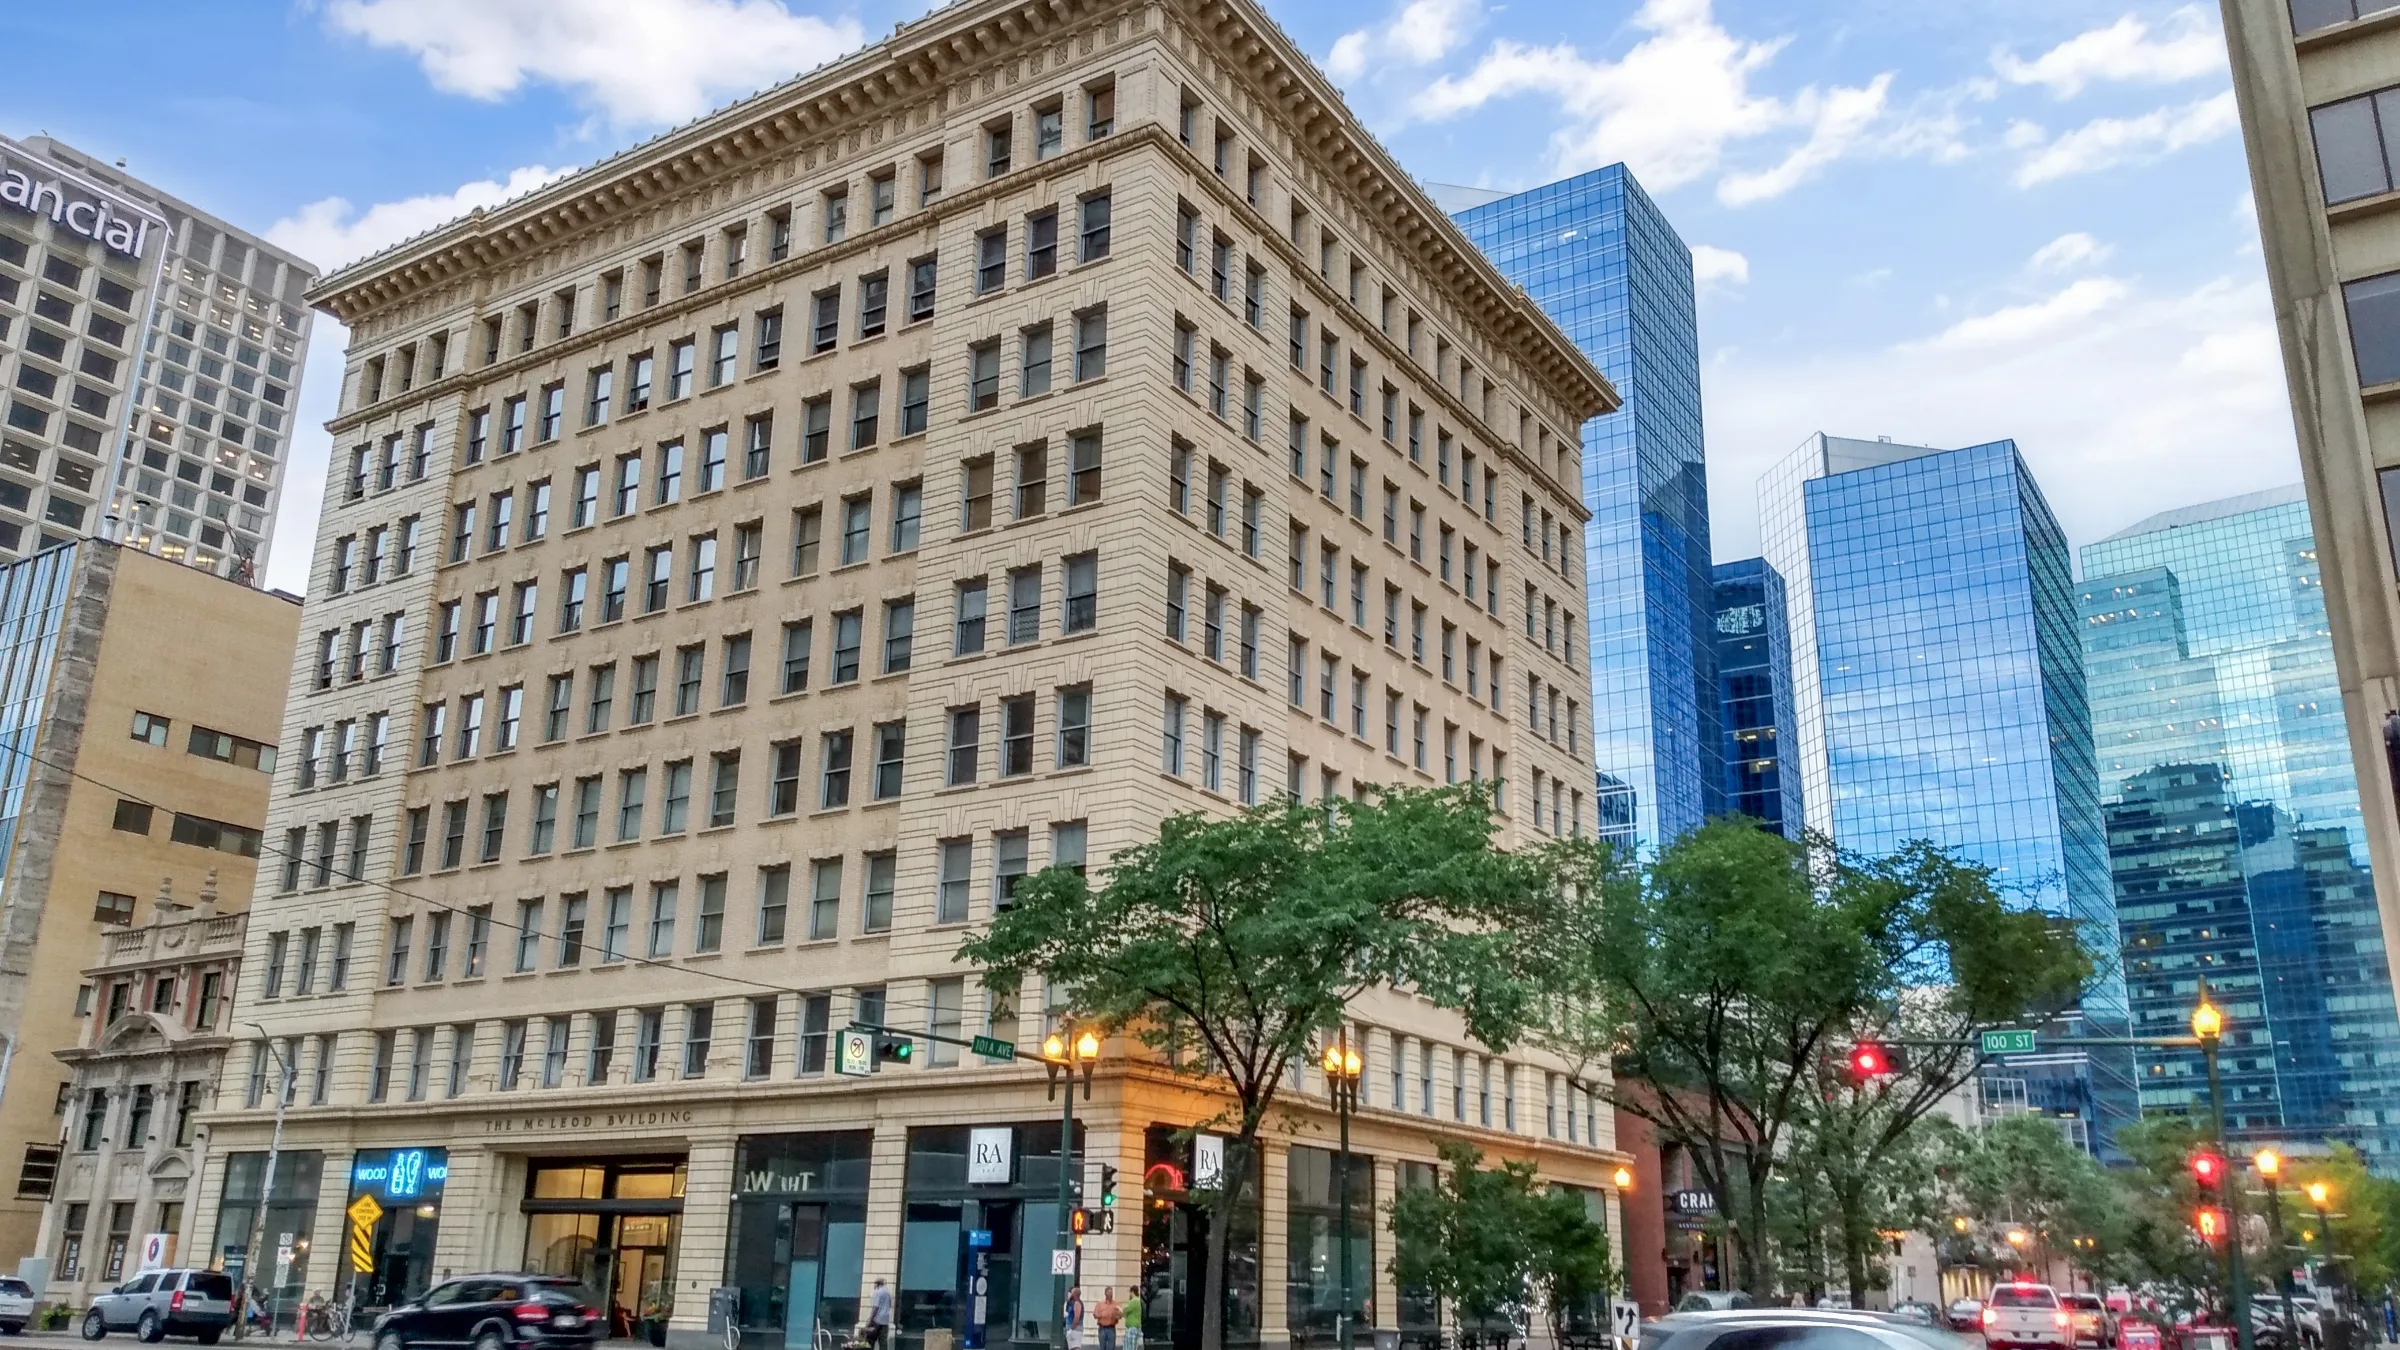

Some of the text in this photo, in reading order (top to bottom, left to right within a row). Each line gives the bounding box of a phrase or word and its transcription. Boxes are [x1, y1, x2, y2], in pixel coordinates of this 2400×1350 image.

[974, 1039, 1013, 1058] 101A AVE
[1986, 1034, 2029, 1049] 100 ST
[485, 1120, 512, 1131] THE
[976, 1143, 1003, 1164] RA
[358, 1168, 387, 1180] WOOD
